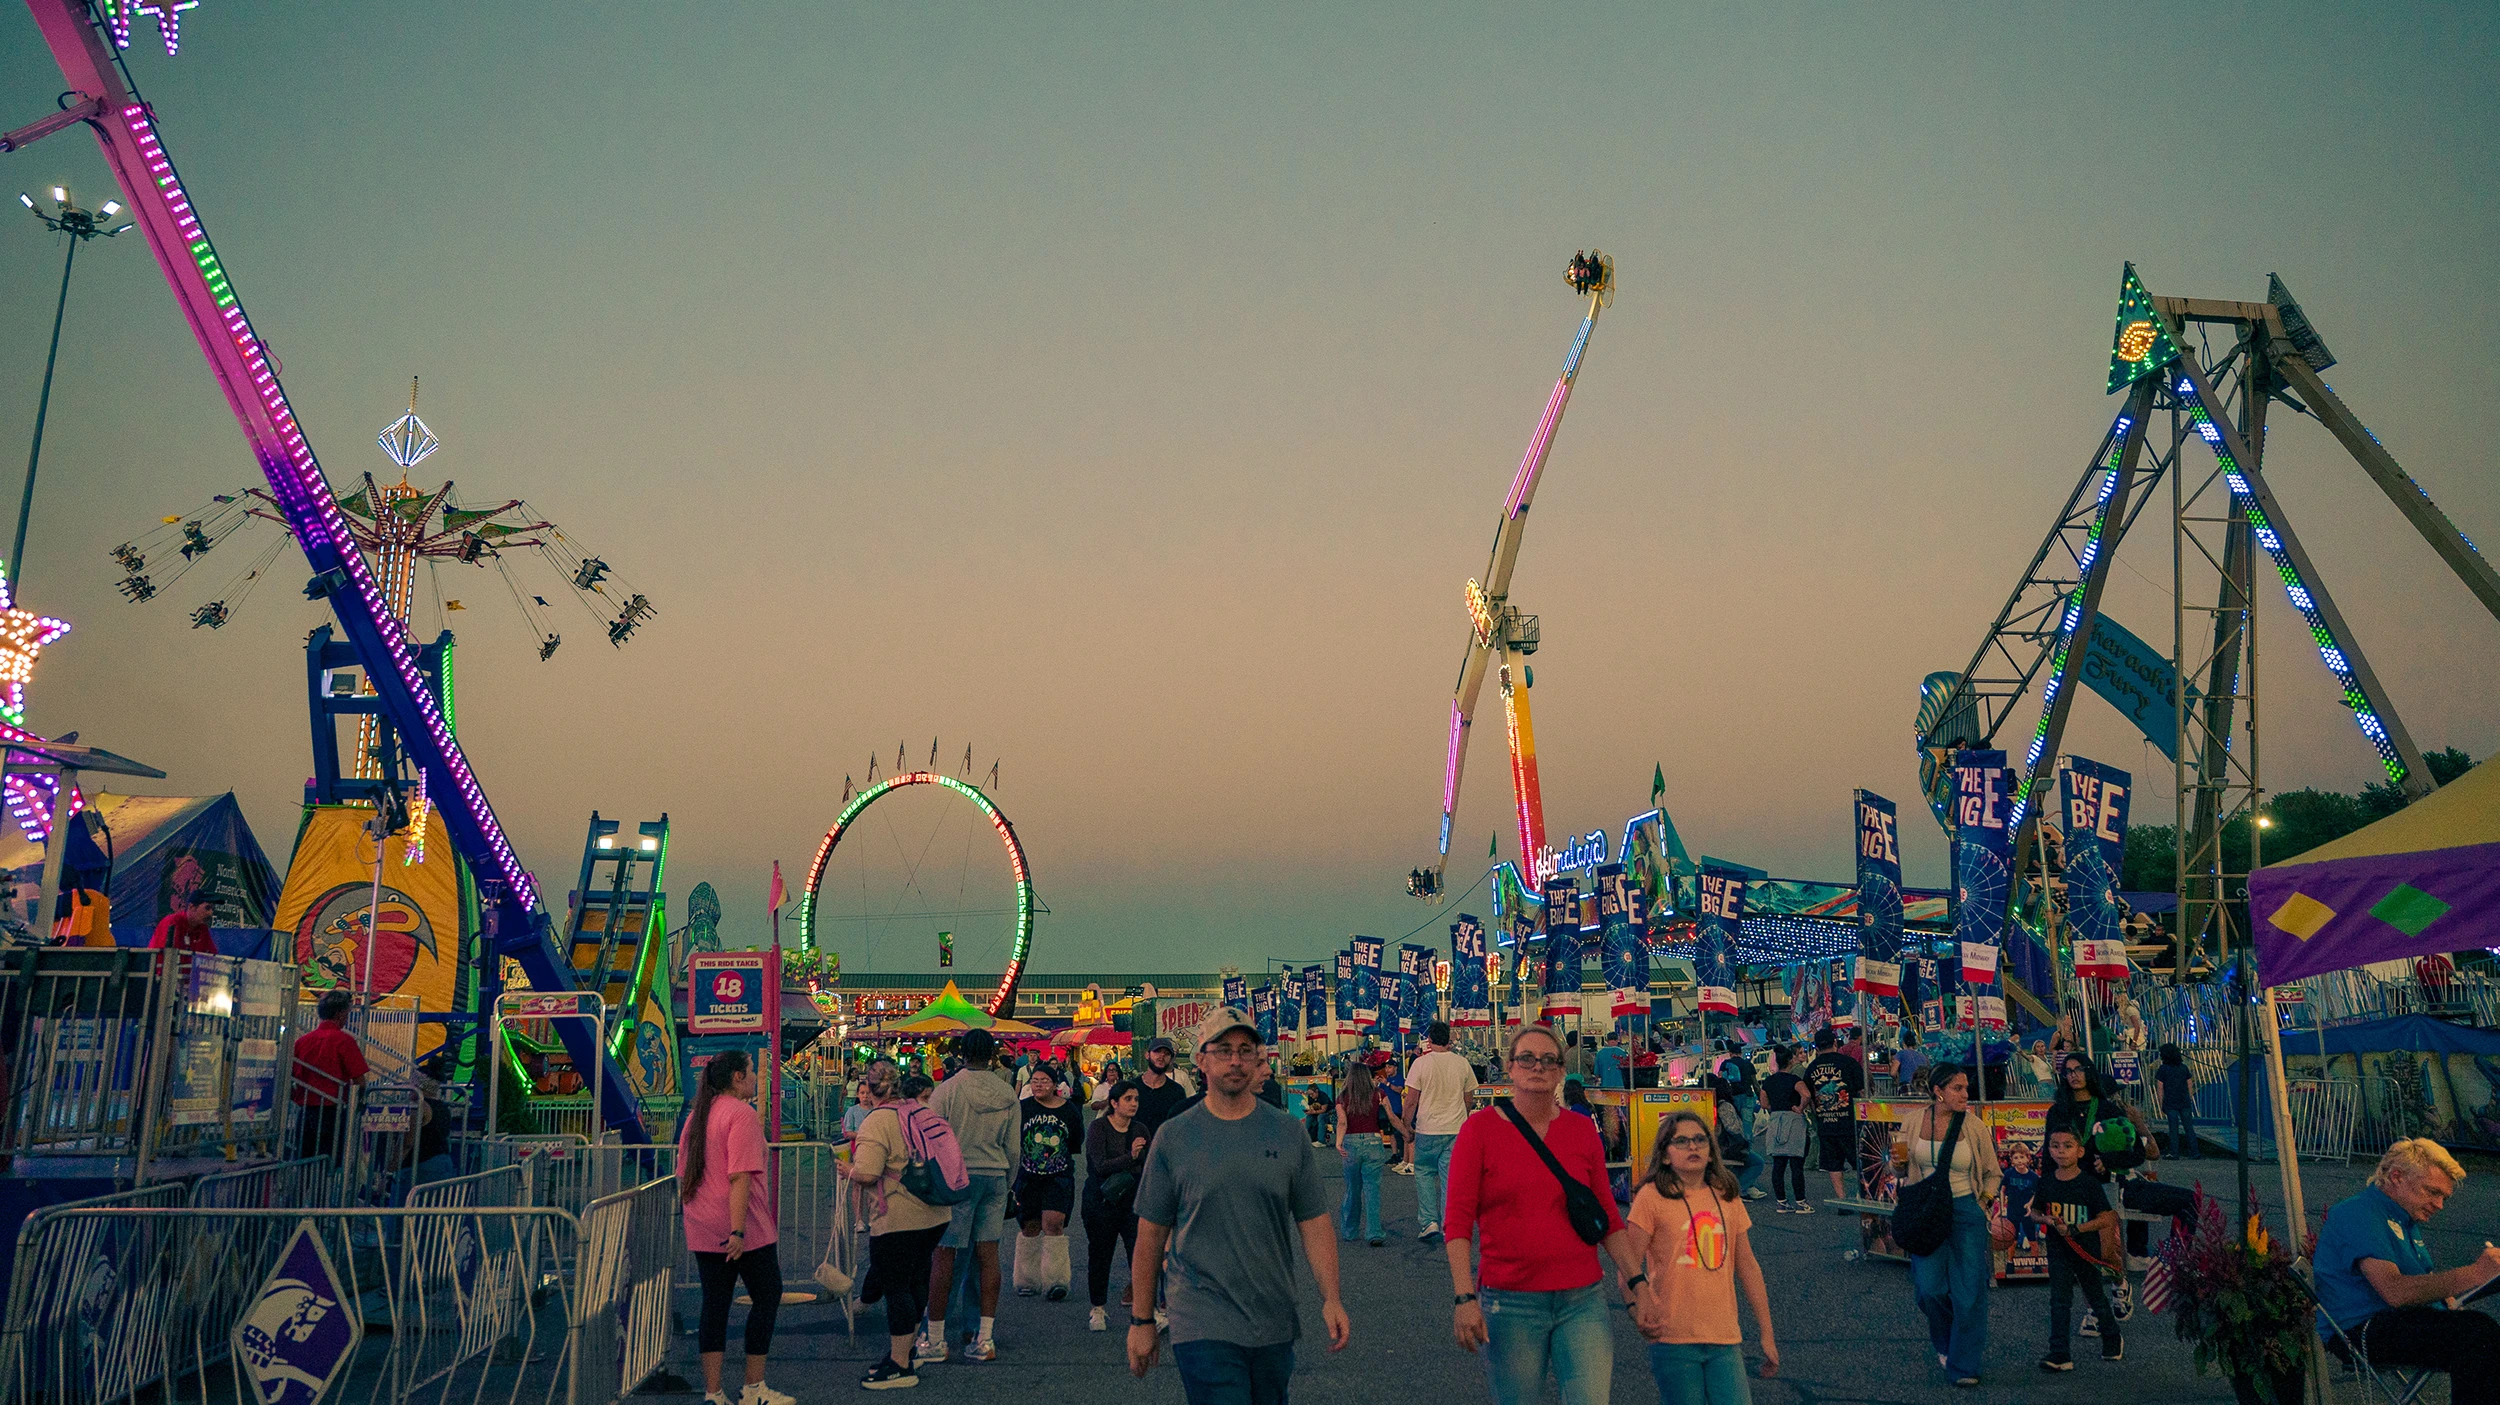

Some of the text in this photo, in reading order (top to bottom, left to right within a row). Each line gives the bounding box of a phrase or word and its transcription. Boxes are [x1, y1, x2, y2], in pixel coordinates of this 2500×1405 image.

[1955, 767, 1982, 793] THE
[2068, 771, 2100, 803] THE
[1959, 768, 2003, 829] IG E
[1860, 803, 1882, 830] THE
[2071, 781, 2124, 843] BG E
[1880, 811, 1899, 866] E
[1534, 829, 1608, 892] Himalaya
[215, 881, 247, 898] American
[1601, 875, 1615, 893] THE
[1701, 874, 1725, 895] THE
[1548, 889, 1565, 906] THE
[1549, 888, 1579, 926] BIG E
[1602, 894, 1619, 915] BIG
[1627, 888, 1643, 925] E
[1701, 879, 1742, 920] BG E
[1353, 941, 1369, 953] THE
[1472, 929, 1485, 957] E
[1338, 956, 1351, 967] THE
[1353, 943, 1381, 968] BIG E
[1401, 951, 1418, 975] IG E
[1306, 971, 1316, 981] THE
[1315, 969, 1324, 990] E
[1338, 967, 1352, 979] BIG
[1839, 962, 1847, 981] E
[1925, 959, 1936, 979] E
[716, 977, 742, 998] 18
[1227, 983, 1237, 991] THE
[1228, 980, 1246, 1001] BIG E
[1254, 992, 1267, 1003] THE
[1292, 981, 1302, 1000] E
[1380, 978, 1400, 1001] IG E
[709, 1003, 749, 1014] TICKETS
[1256, 1001, 1269, 1013] BIG
[1267, 990, 1276, 1010] E
[1811, 1066, 1842, 1081] SUZUKA
